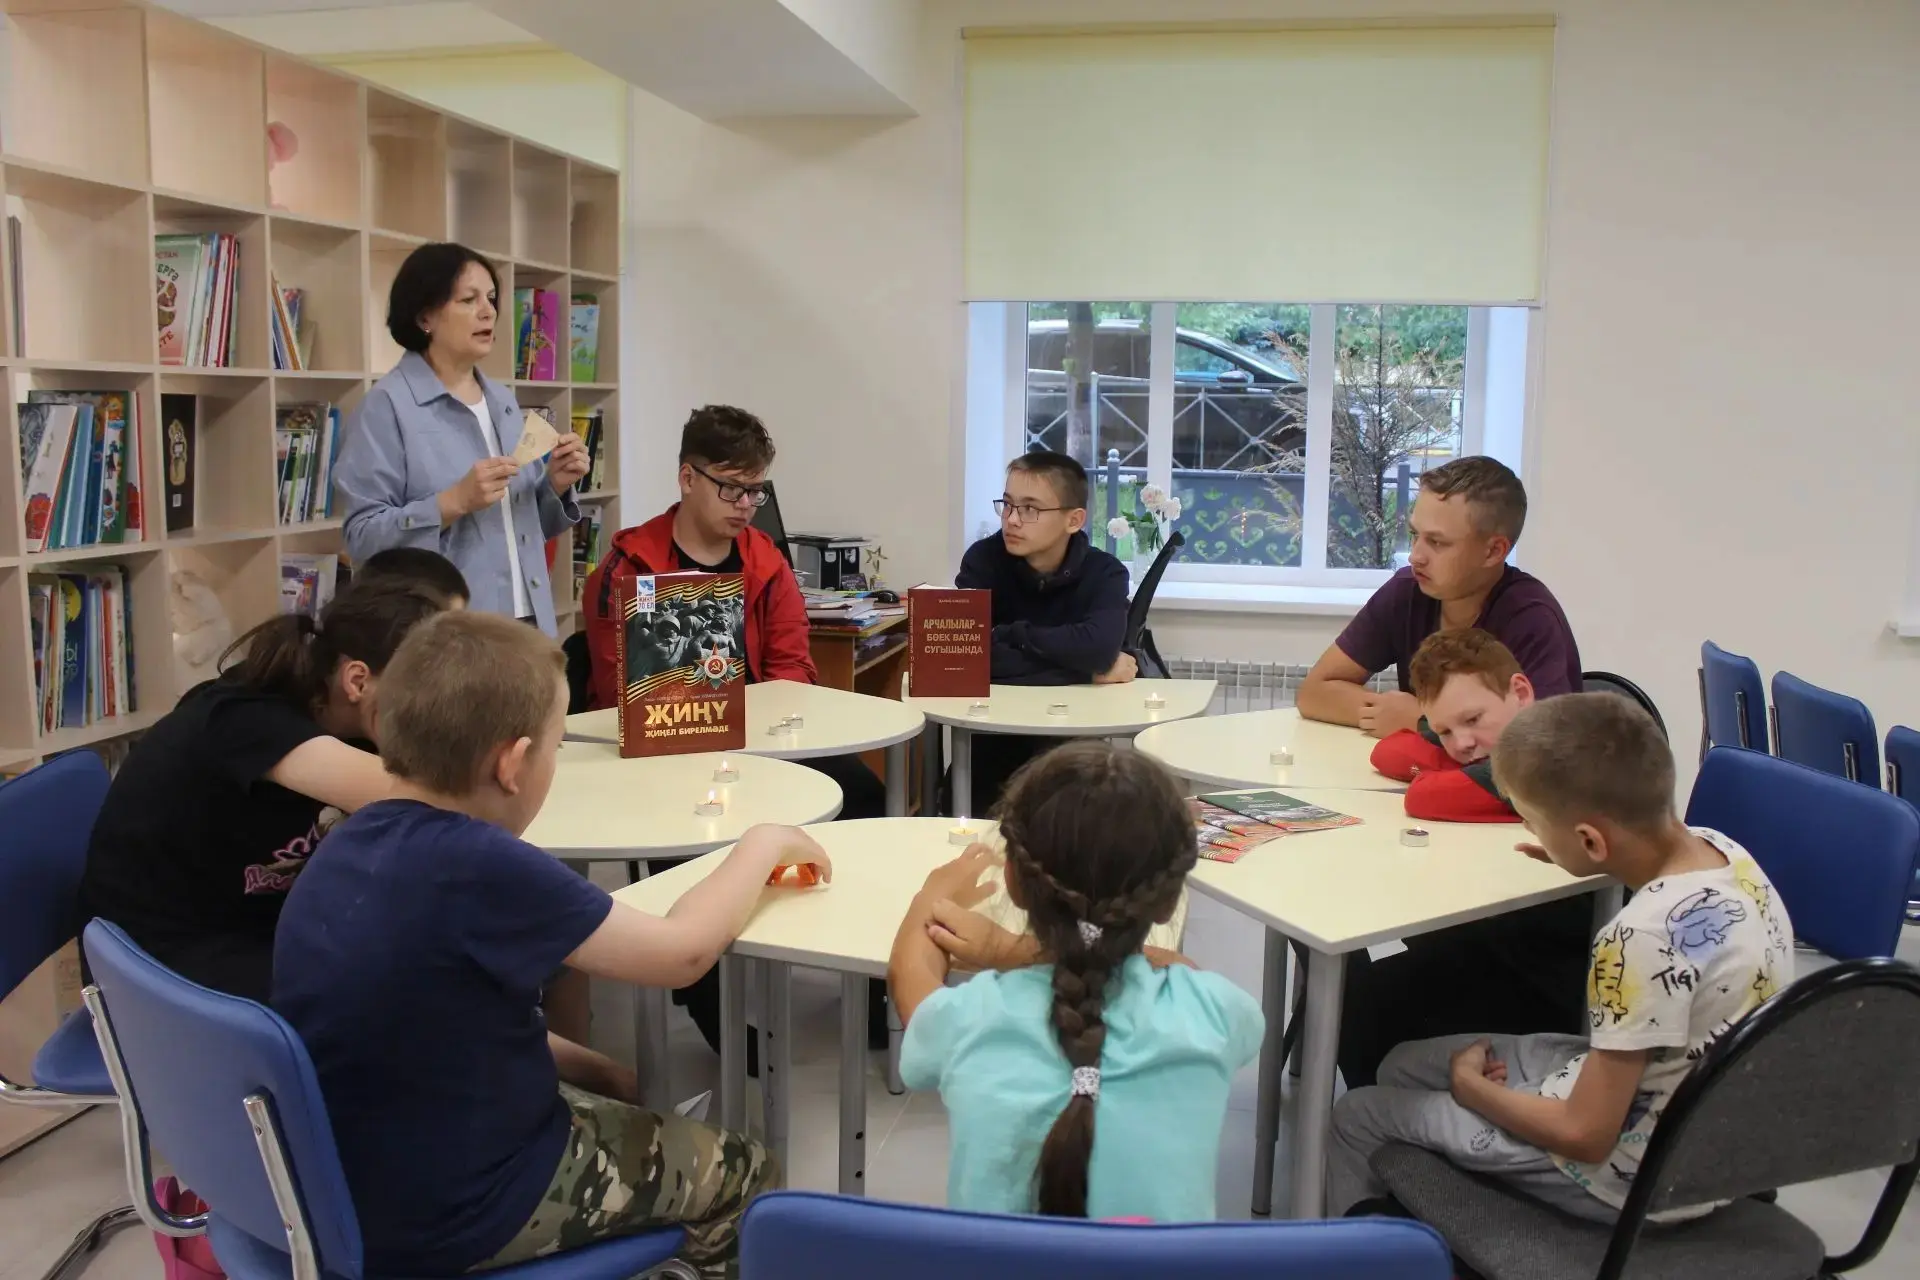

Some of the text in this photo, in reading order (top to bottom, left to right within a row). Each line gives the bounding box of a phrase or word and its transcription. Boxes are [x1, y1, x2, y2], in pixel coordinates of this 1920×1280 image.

[923, 618, 976, 629] АРЧАЛЫЛАР
[952, 633, 981, 642] ВАТАН
[924, 645, 984, 655] СУГЫШЫНДА
[678, 724, 729, 736] БИРЕЛМӘДЕ
